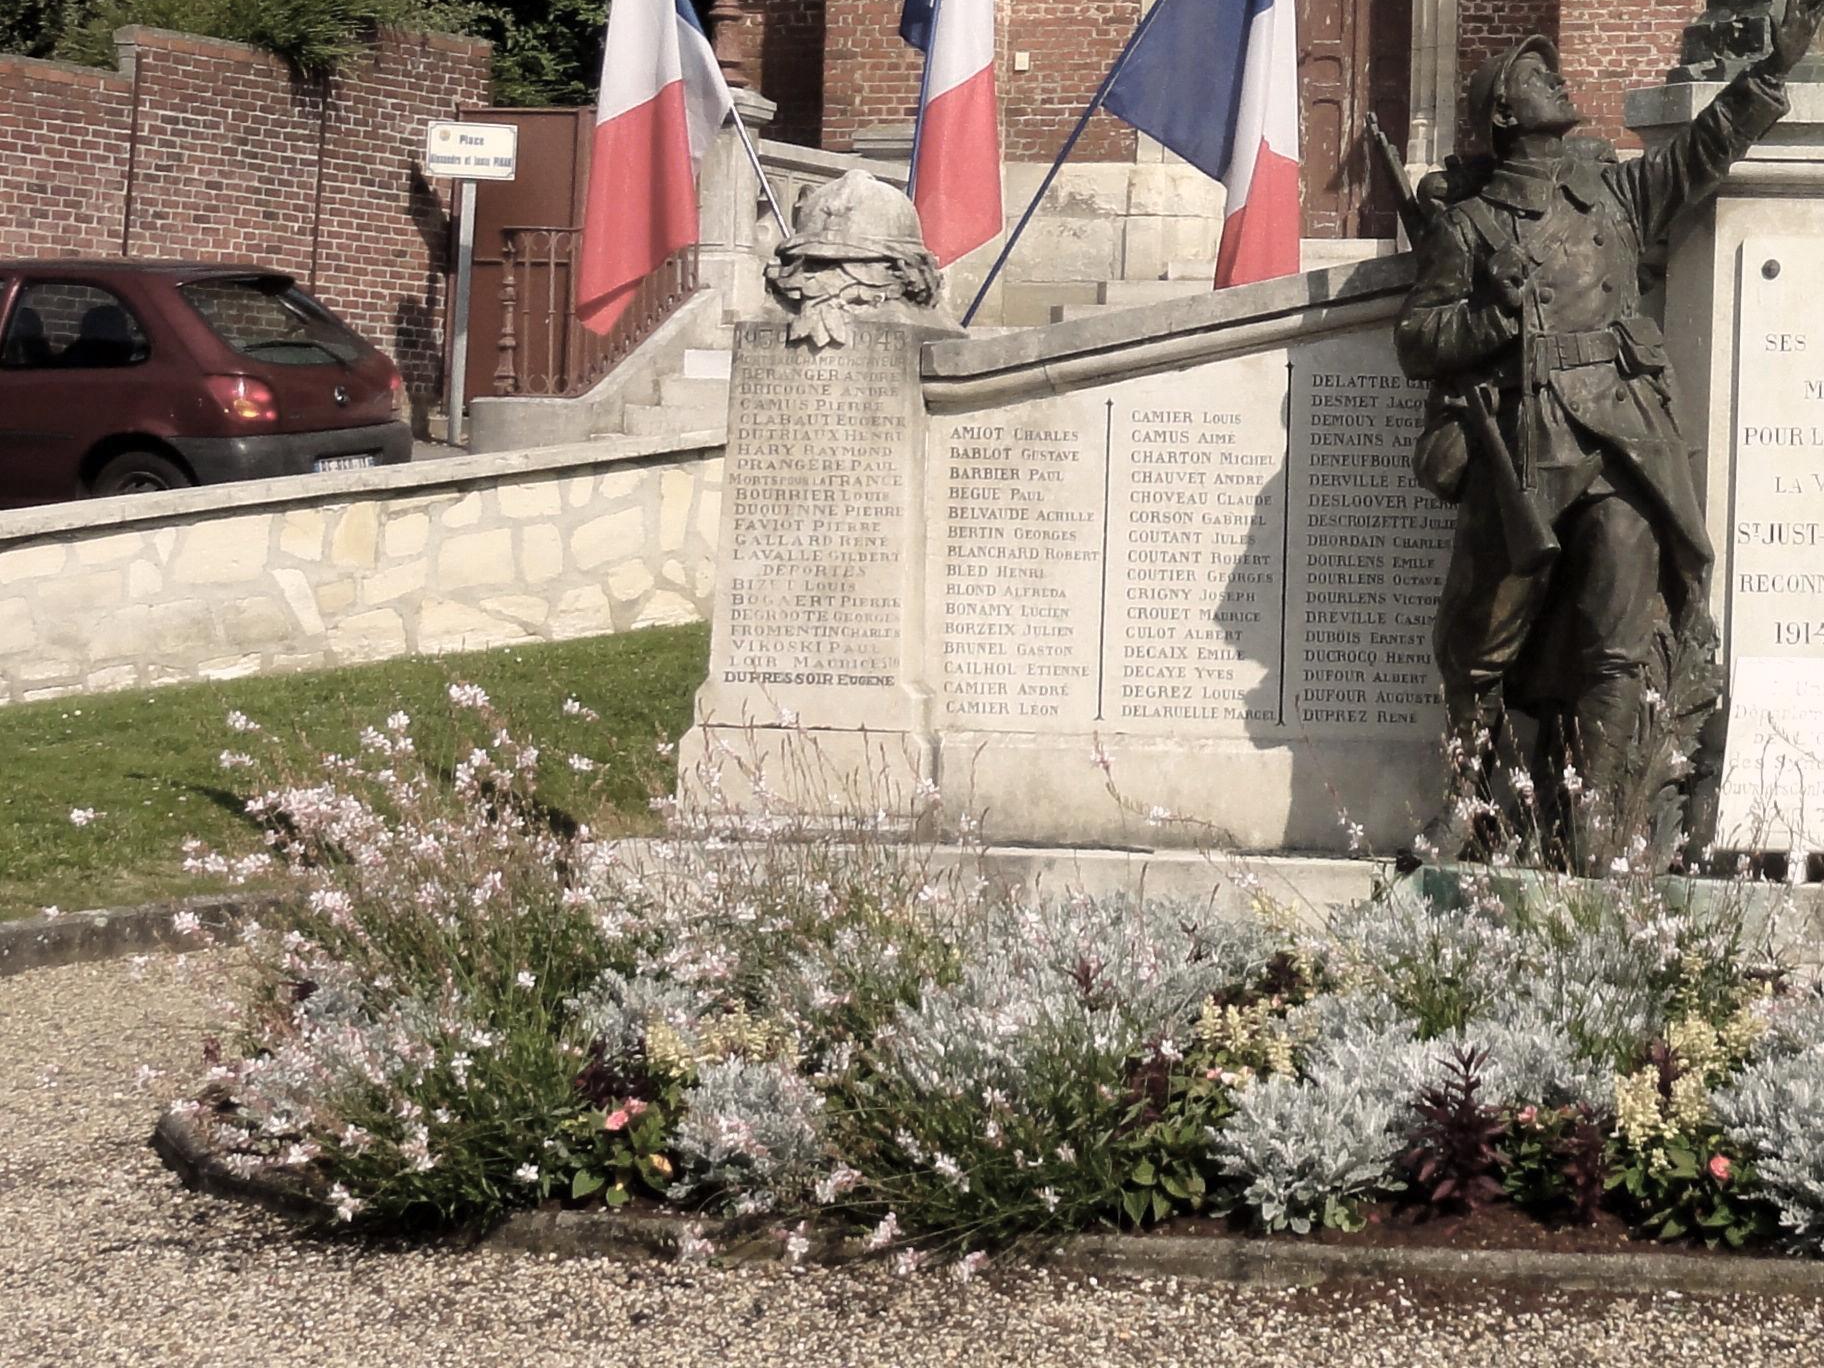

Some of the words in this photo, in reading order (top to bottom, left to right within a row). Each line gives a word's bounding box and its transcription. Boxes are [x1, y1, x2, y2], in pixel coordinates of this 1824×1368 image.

[1765, 334, 1807, 352] SES
[1313, 374, 1400, 389] DELATTRE
[1311, 395, 1379, 408] DESMET
[1132, 410, 1192, 424] CAMIER
[1203, 412, 1241, 424] LOUIS
[1311, 414, 1376, 427] DEMOUY
[950, 427, 1004, 440] AMIOT
[1014, 428, 1079, 442] CHARLES
[1131, 429, 1189, 444] CAMUS
[1311, 433, 1383, 447] DENAINS
[1745, 427, 1804, 446] POUR
[950, 447, 1012, 460] BABLOT
[1022, 448, 1079, 462] GUSTAVE
[1131, 451, 1211, 464] CHARTON
[1220, 452, 1275, 465] MICHEL
[950, 467, 1020, 480] BARBIER
[1029, 469, 1064, 481] PAUL
[1131, 471, 1206, 485] CHAUVET
[1775, 477, 1802, 493] LA
[1010, 488, 1044, 501] PAUL
[1130, 491, 1208, 505] CHOVEAU
[1217, 493, 1272, 505] CLAUDE
[1309, 494, 1406, 508] DESLOOVER
[949, 507, 1029, 521] BELVAUDE
[1036, 509, 1094, 522] ACHILLE
[1130, 511, 1193, 524] CORSON
[1202, 512, 1266, 526] GABRIEL
[1308, 515, 1417, 528] DESCROIZETTE
[948, 526, 1004, 539] BERTIN
[1014, 528, 1077, 541] GEORGES
[1129, 530, 1202, 544] COUTANT
[1212, 532, 1256, 544] JULES
[1308, 534, 1385, 548] DHORDAIN
[947, 545, 1039, 560] BLANCHARD
[1046, 548, 1098, 561] ROBERT
[1128, 550, 1201, 563] COUTANT
[1212, 552, 1270, 565] ROBERT
[1307, 555, 1384, 567] DOURLENS
[1393, 557, 1435, 569] EMILE
[947, 565, 988, 577] BLED
[997, 566, 1044, 579] HENRI
[1307, 573, 1384, 585] DOURLENS
[1393, 574, 1443, 586] OCTAVE
[1127, 588, 1192, 600] CRIGNY
[1200, 589, 1255, 602] JOSEPH
[946, 603, 1012, 616] BONAMY
[1021, 604, 1070, 618] LUCIEN
[1305, 631, 1360, 644] DUBOIS
[1371, 632, 1426, 645] ERNEST
[944, 641, 1007, 655] BRUNEL
[1017, 644, 1073, 656] GASTON
[1305, 650, 1377, 666] DUCROCQ
[1386, 652, 1431, 664] HENRI
[724, 672, 833, 685] DUPRESSOIR
[1124, 665, 1186, 679] DECAYE
[1194, 667, 1234, 680] YVES
[1304, 670, 1365, 682] DUFOUR
[1373, 672, 1427, 684] ALBERT
[944, 681, 1007, 695] CAMIER
[1123, 685, 1192, 698] DEGREZ
[1203, 687, 1245, 700] LOUIS
[1304, 689, 1366, 702] DUFOUR
[1375, 690, 1441, 704] AUGUSTE
[947, 701, 1009, 714] CAMIER
[1122, 705, 1219, 719] DELARUELLE
[1224, 707, 1277, 721] MARCEL
[1303, 709, 1368, 723] DUPREZ
